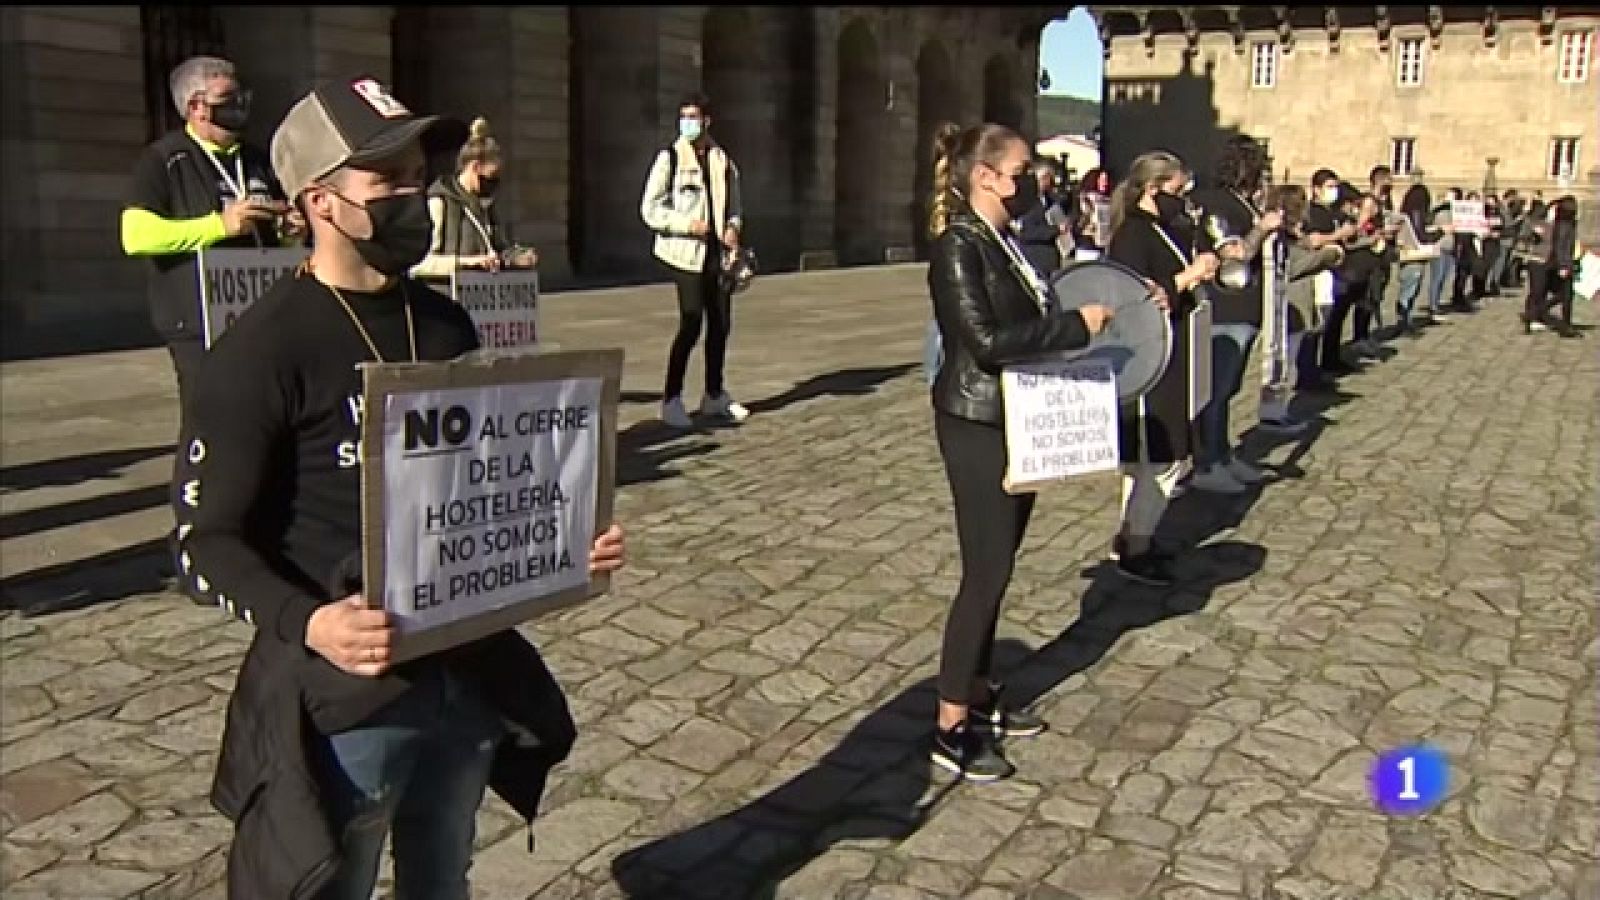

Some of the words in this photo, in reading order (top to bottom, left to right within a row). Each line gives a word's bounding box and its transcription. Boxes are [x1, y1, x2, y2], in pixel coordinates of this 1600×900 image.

[403, 405, 472, 450] NO
[479, 414, 509, 441] AL
[513, 405, 591, 436] CIERRE
[1032, 434, 1053, 451] NO
[469, 456, 501, 485] DE
[506, 451, 534, 478] LA
[439, 535, 476, 567] NO
[483, 516, 559, 556] SOMOS
[414, 582, 443, 611] EL
[449, 549, 576, 601] PROBLEMA.
